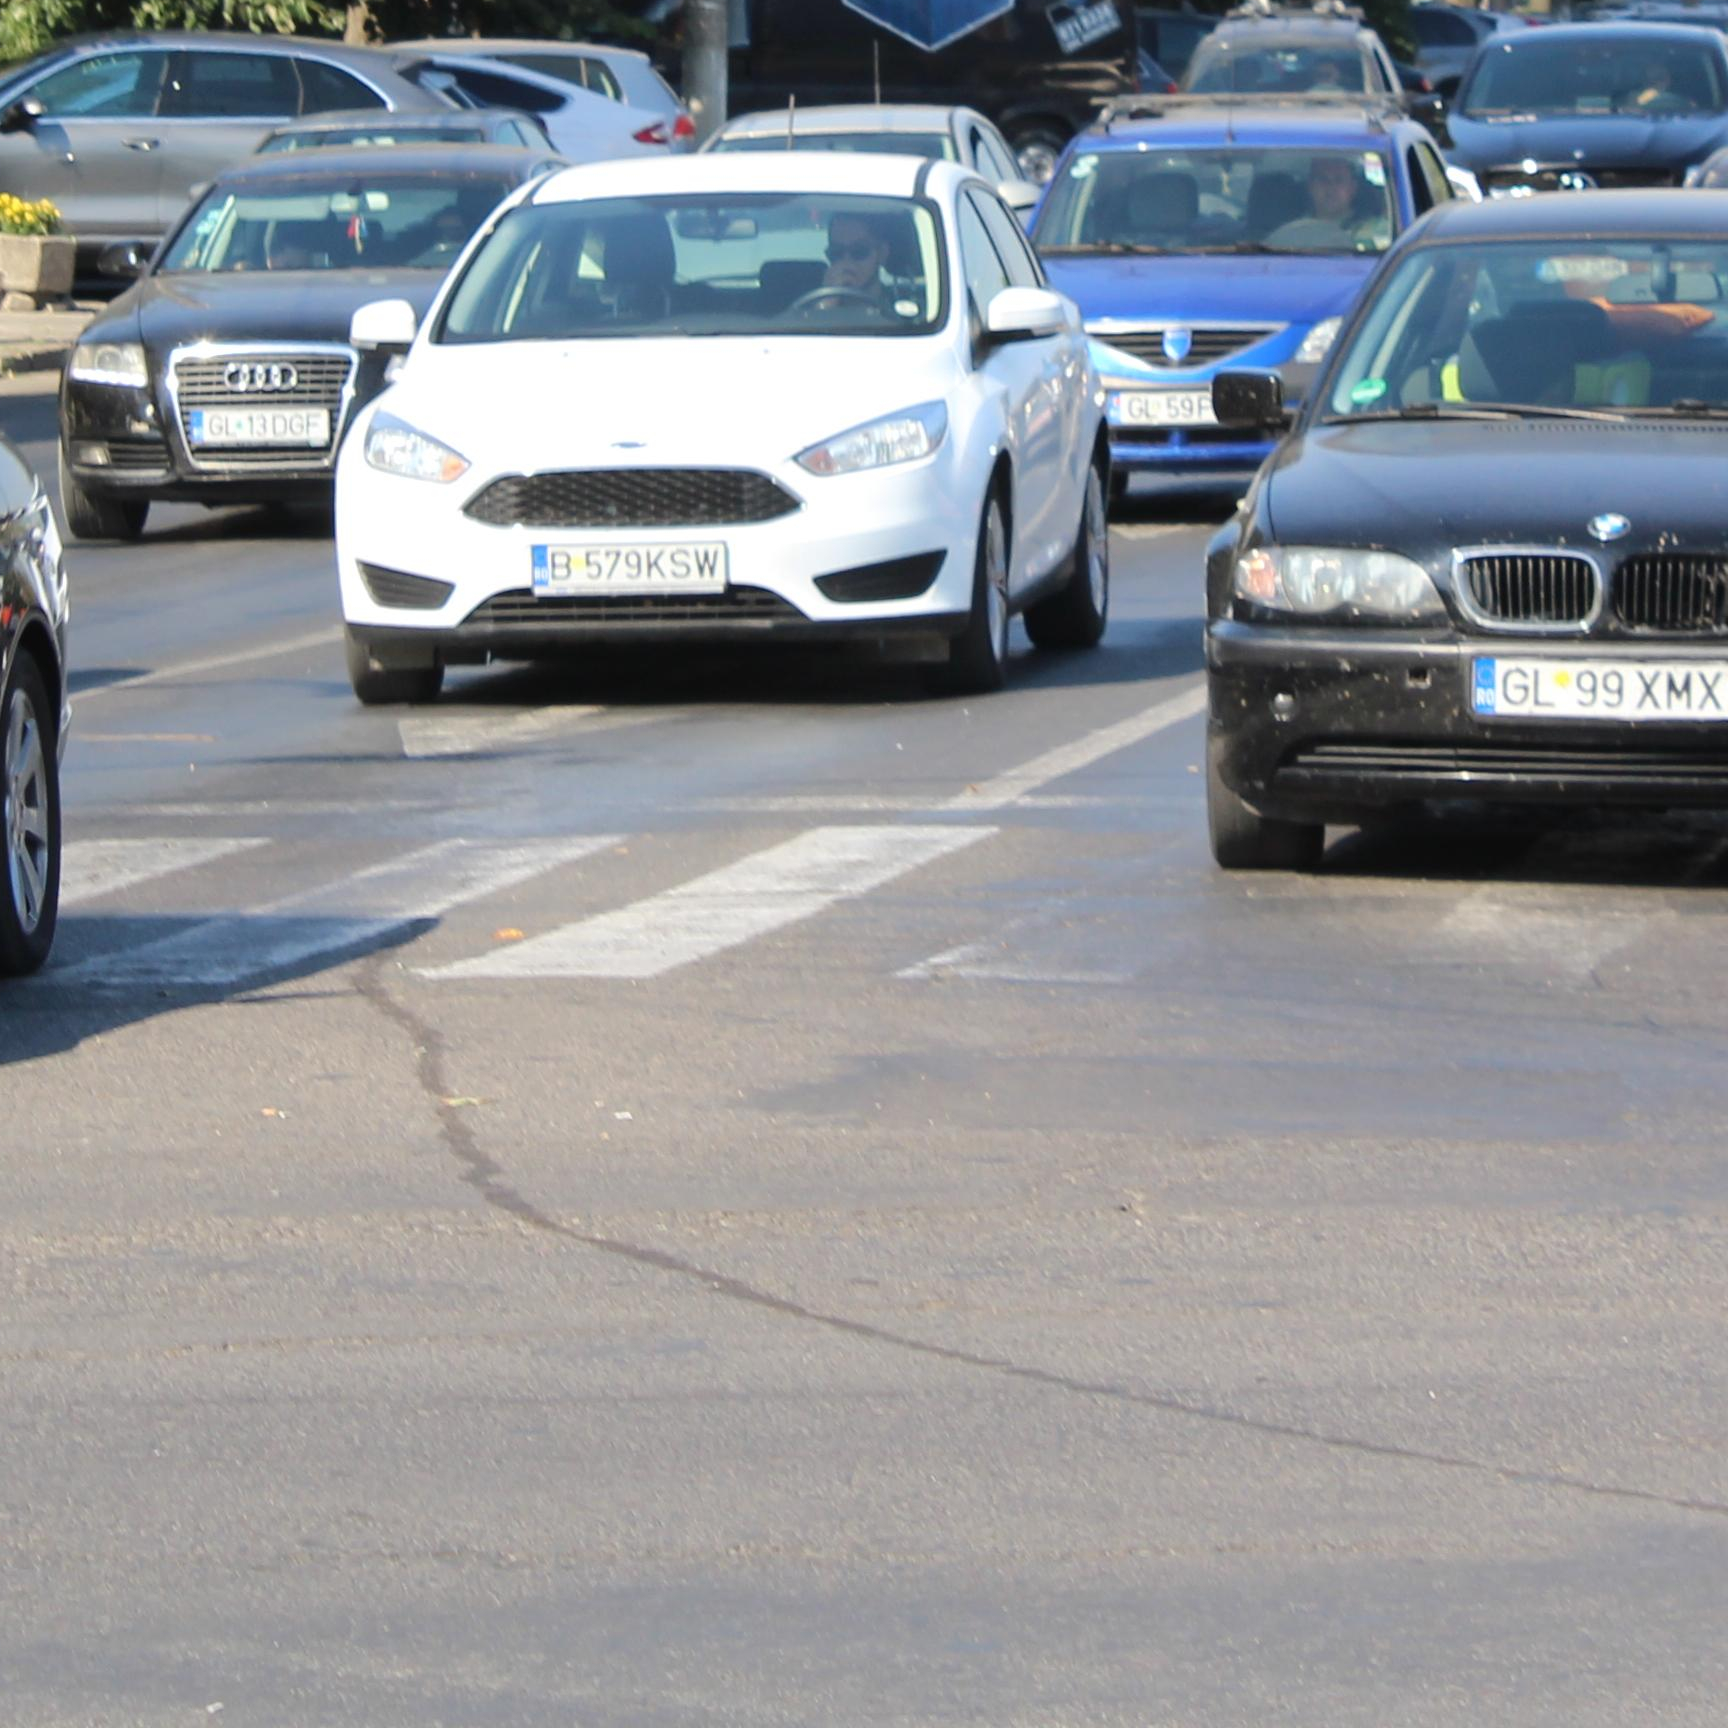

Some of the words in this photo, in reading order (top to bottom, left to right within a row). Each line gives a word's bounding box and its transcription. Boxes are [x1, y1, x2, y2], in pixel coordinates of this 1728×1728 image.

[1128, 396, 1158, 419] GL
[208, 415, 236, 438] GL
[248, 415, 269, 438] 13
[550, 550, 573, 580] B
[584, 548, 719, 580] 579KSW
[1476, 687, 1495, 705] RO
[1502, 668, 1555, 707] GL
[1575, 670, 1624, 708] 99
[1636, 670, 1724, 711] XMX
